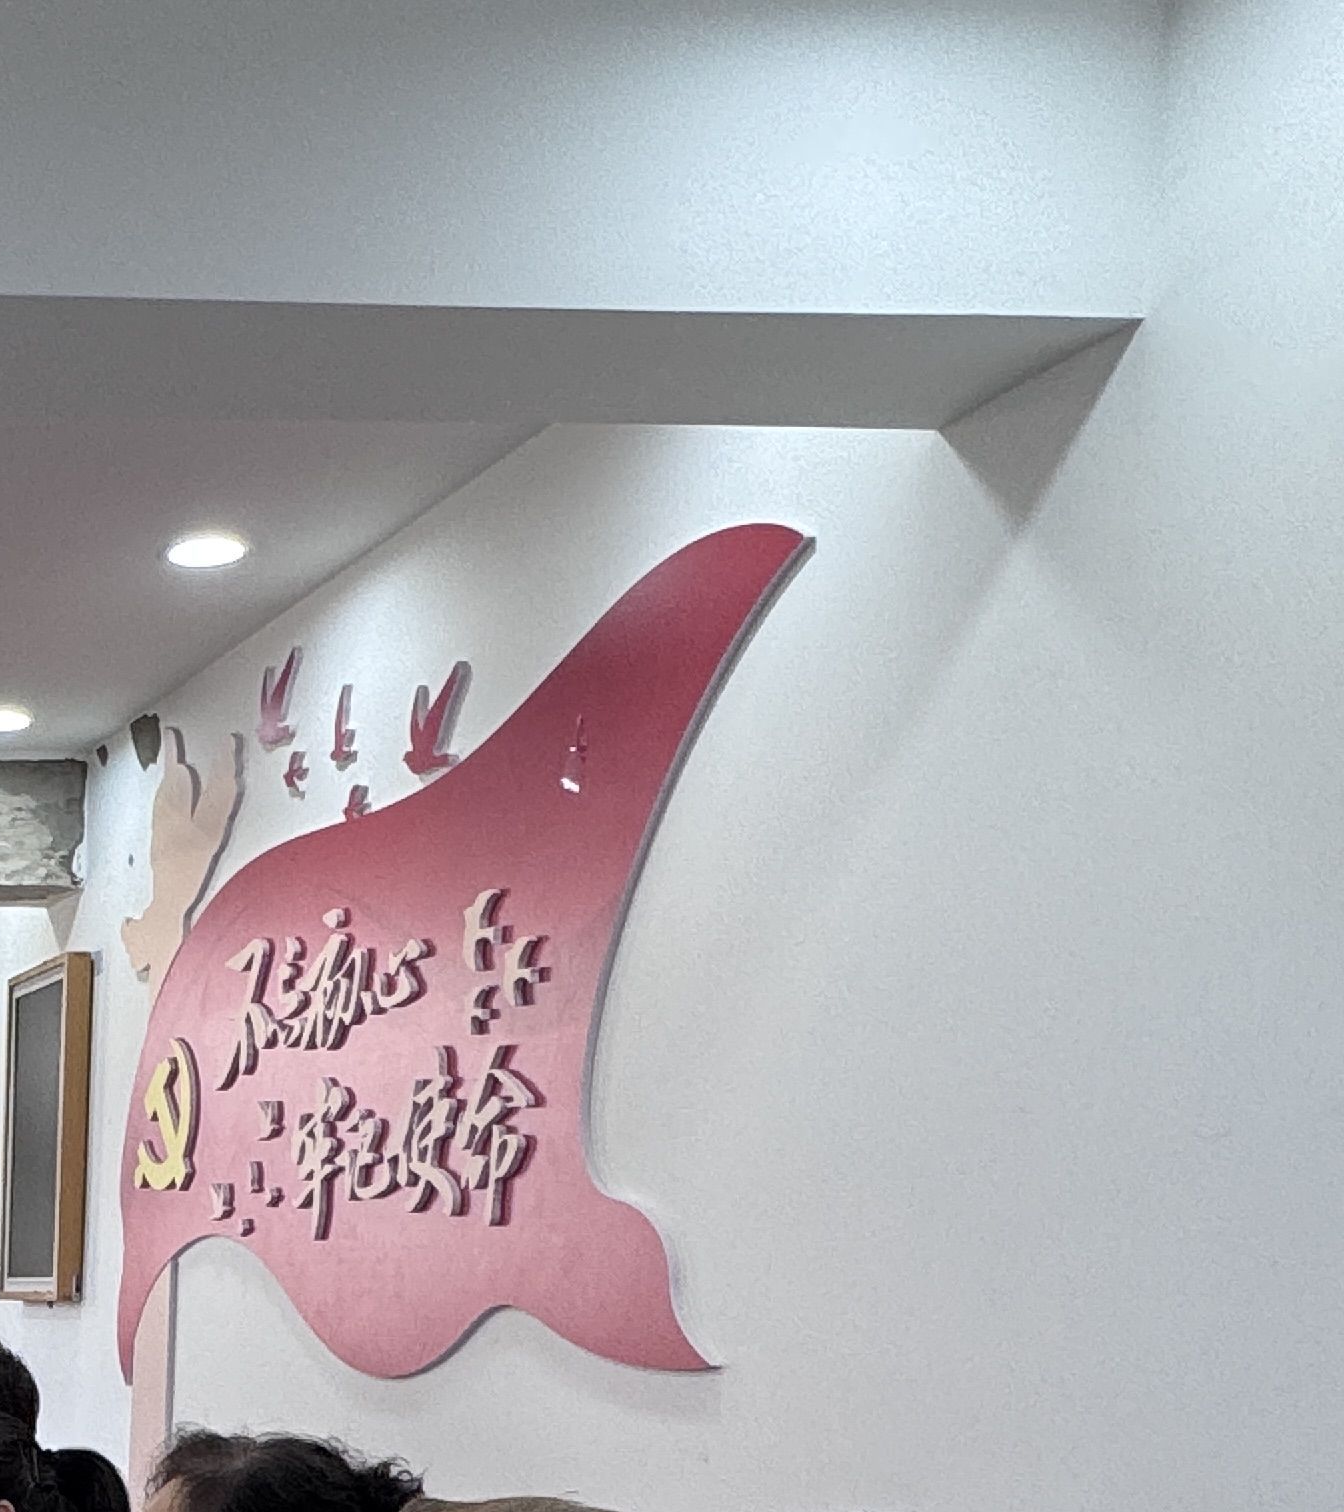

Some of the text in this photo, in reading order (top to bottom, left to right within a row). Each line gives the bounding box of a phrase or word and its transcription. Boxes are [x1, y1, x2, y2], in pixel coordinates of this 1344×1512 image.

[216, 908, 434, 1090] 不忘初心
[291, 1045, 544, 1240] 牢记使命
